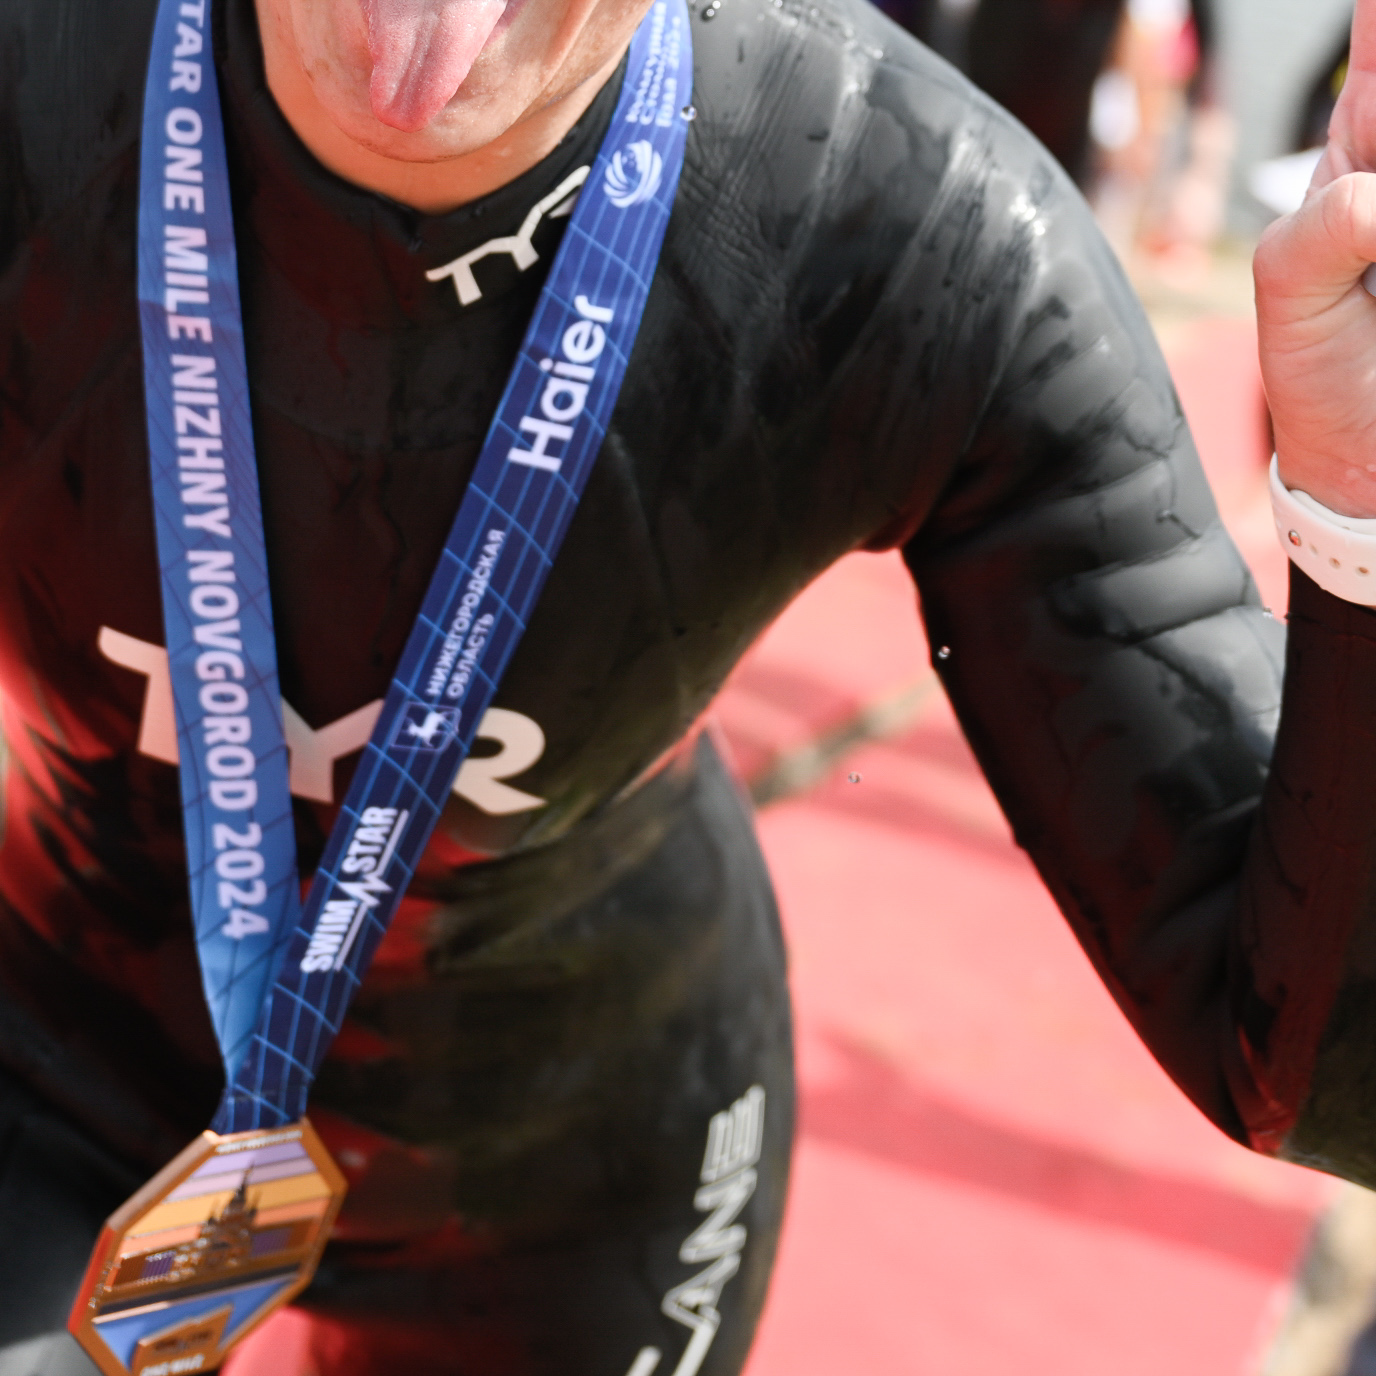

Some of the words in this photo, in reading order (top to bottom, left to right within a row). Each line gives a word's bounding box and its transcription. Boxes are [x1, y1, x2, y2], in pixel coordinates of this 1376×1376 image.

[162, 106, 205, 214] ONE
[163, 224, 213, 343] MILE
[170, 354, 232, 538] NIZHNY
[506, 295, 614, 472] Haier
[186, 550, 258, 811] NOVGOROD
[426, 528, 506, 697] НИЖЕГОРОДСКАЯ
[446, 613, 495, 699] ОБЛАСТЬ
[212, 822, 269, 940] 2024
[300, 900, 359, 973] SWIM
[341, 806, 399, 874] STAR
